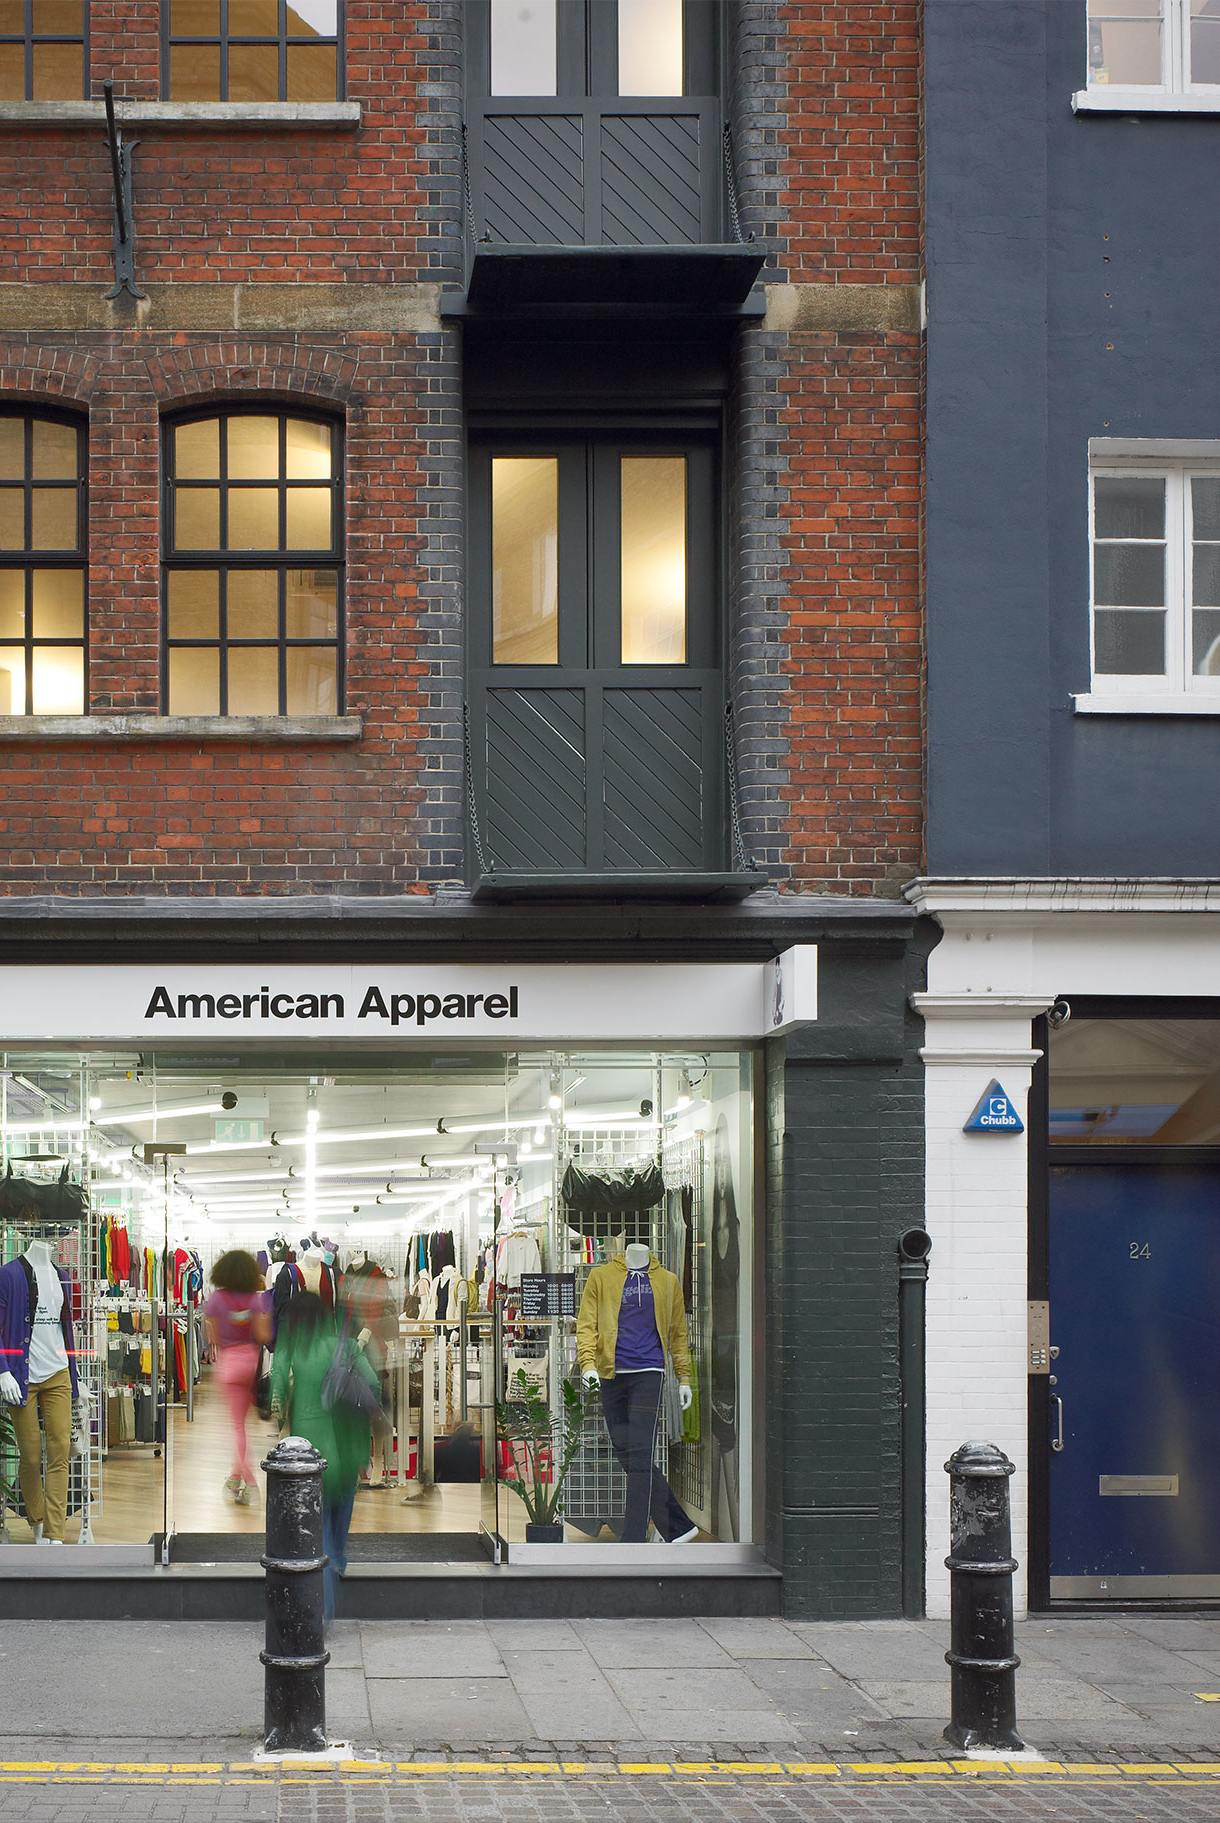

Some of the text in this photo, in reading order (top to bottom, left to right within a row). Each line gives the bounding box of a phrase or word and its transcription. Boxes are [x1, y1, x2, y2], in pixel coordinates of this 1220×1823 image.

[145, 986, 518, 1025] American Apparel
[980, 1116, 1016, 1125] Chubb
[1130, 1242, 1151, 1259] 24
